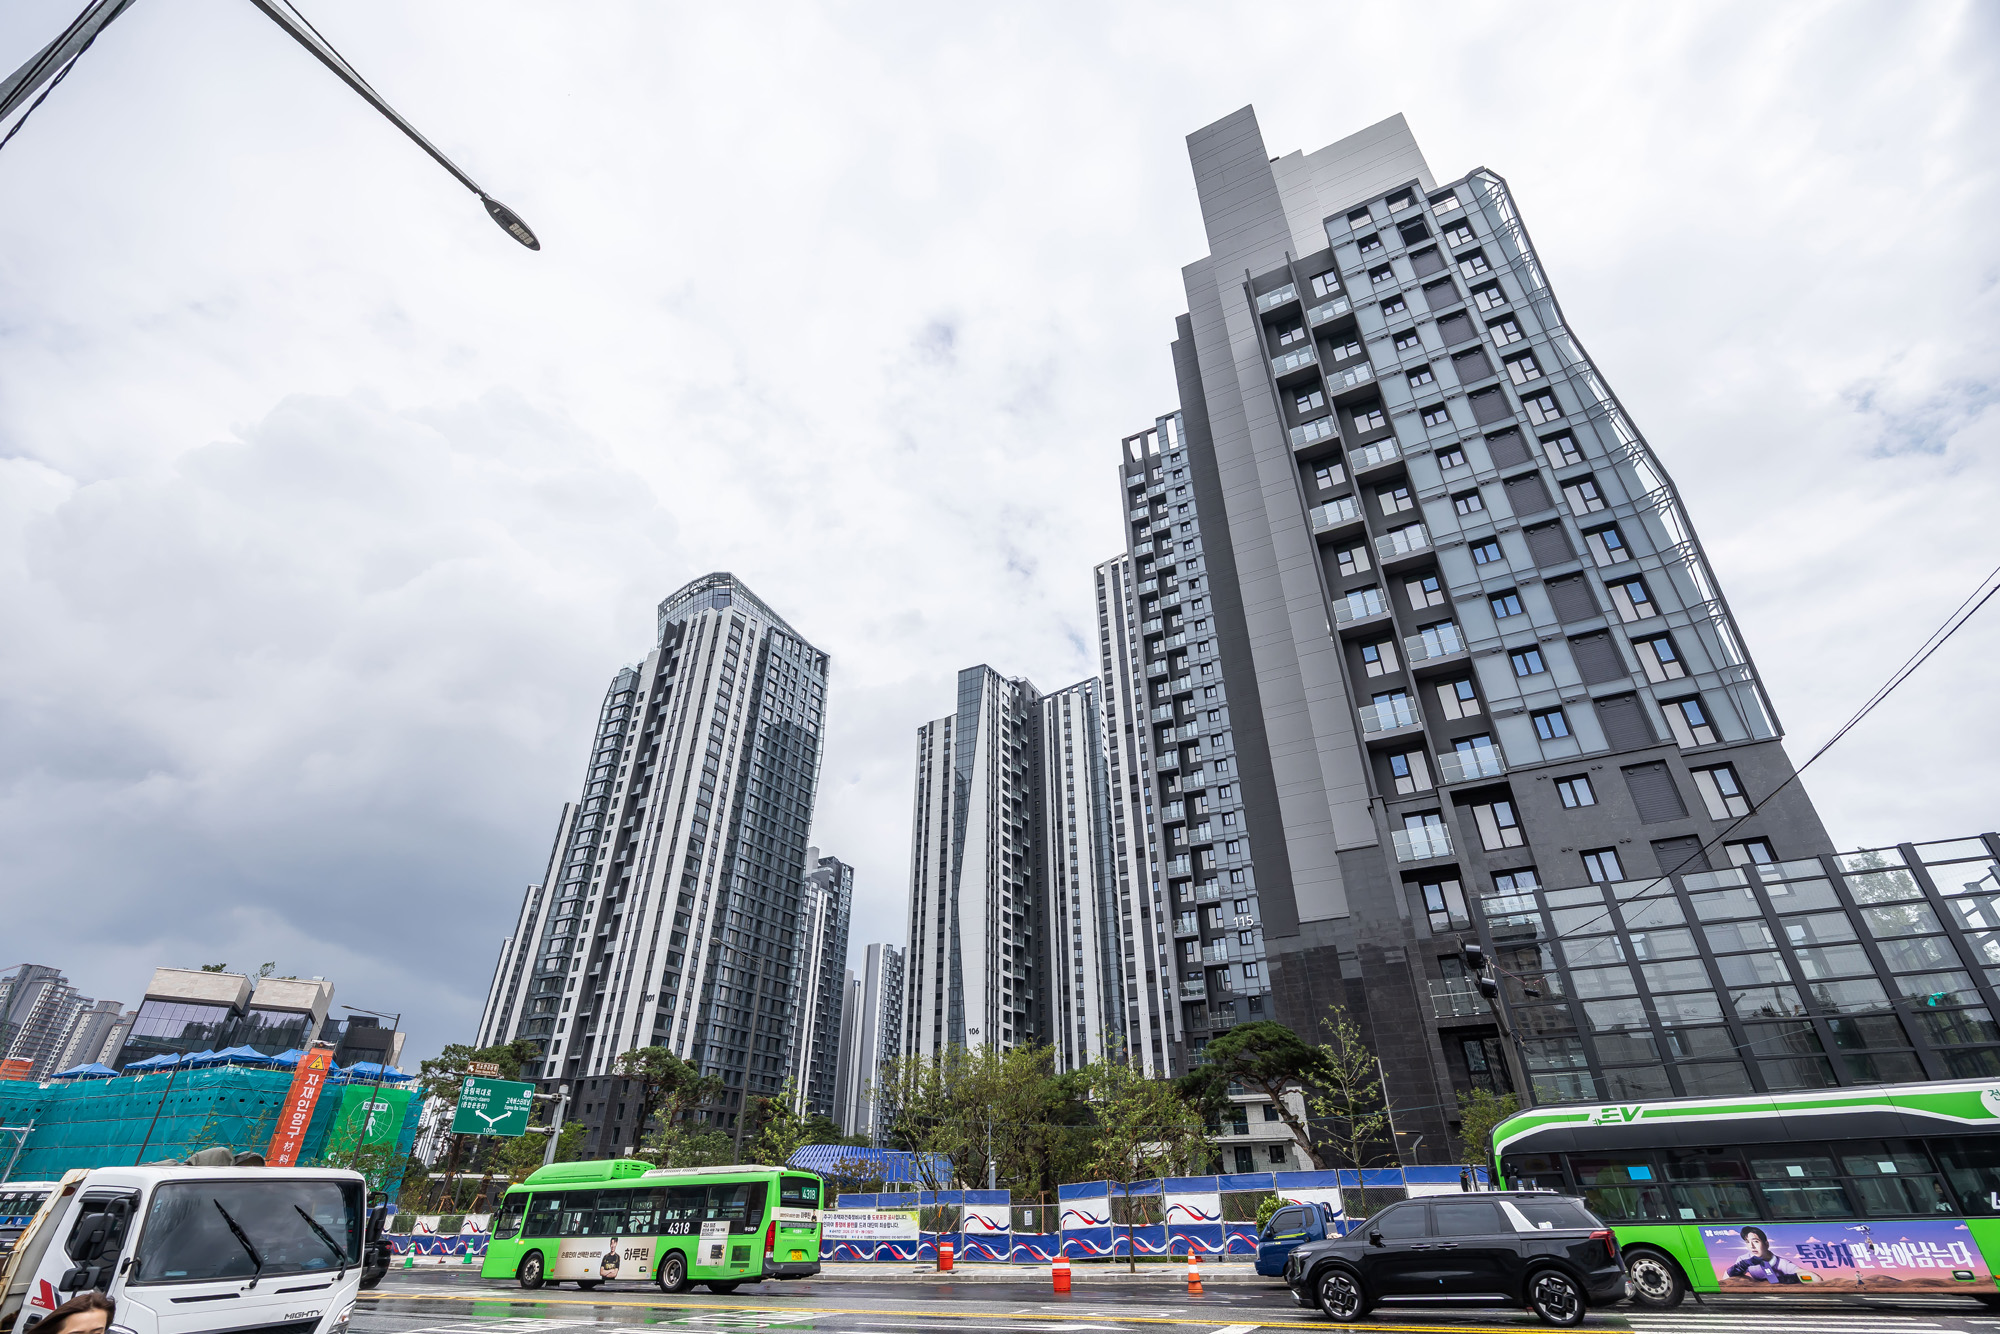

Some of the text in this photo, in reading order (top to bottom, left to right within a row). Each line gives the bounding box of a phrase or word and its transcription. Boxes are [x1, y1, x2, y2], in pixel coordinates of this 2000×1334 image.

[1233, 915, 1254, 927] 115
[969, 1027, 980, 1035] 106
[464, 1087, 492, 1096] 올림픽대로
[462, 1095, 490, 1103] Olympic-daero
[506, 1097, 530, 1106] 고속버스터미널
[461, 1102, 488, 1110] (종합운동장)
[279, 1073, 320, 1165] 자재인양구 材料
[1600, 1106, 1642, 1123] EV
[803, 1188, 816, 1200] 4318
[667, 1222, 691, 1235] 4318
[561, 1251, 602, 1259] 손흥민이 선택한 비타민
[623, 1247, 649, 1261] 하루틴
[1795, 1241, 1975, 1269] 독한자만 살아남는다
[284, 1309, 324, 1320] MIGHTY
